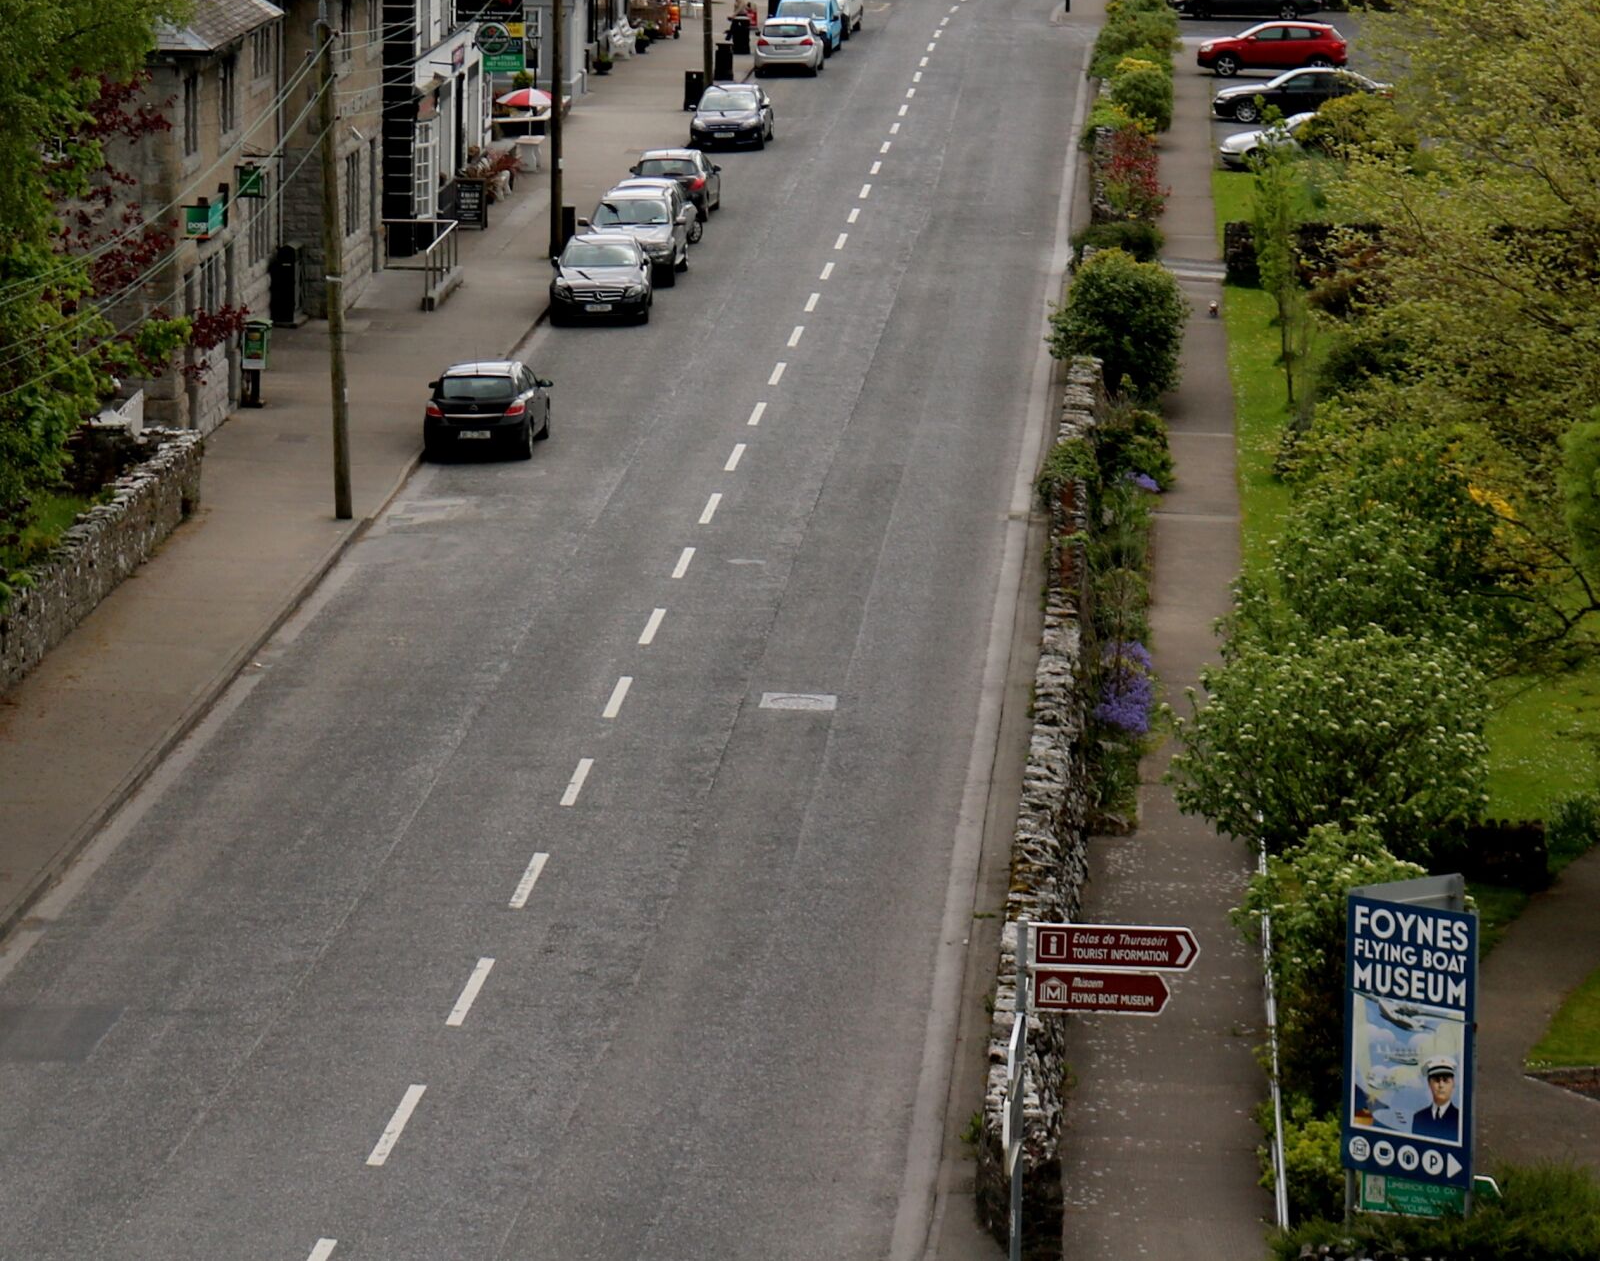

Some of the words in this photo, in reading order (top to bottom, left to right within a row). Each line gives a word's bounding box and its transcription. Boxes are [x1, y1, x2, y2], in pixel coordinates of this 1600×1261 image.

[1072, 932, 1099, 944] Eolas
[1102, 933, 1115, 944] do
[1355, 904, 1469, 952] FOYNES
[1072, 948, 1108, 960] TOURIST
[1110, 949, 1169, 962] INFORMATION
[1354, 938, 1418, 966] FLYING
[1422, 948, 1467, 974] BOAT
[1353, 959, 1467, 1007] MUSEUM
[1071, 992, 1097, 1004] FLYING
[1098, 993, 1119, 1005] BOAT
[1120, 994, 1154, 1006] MUSEUM
